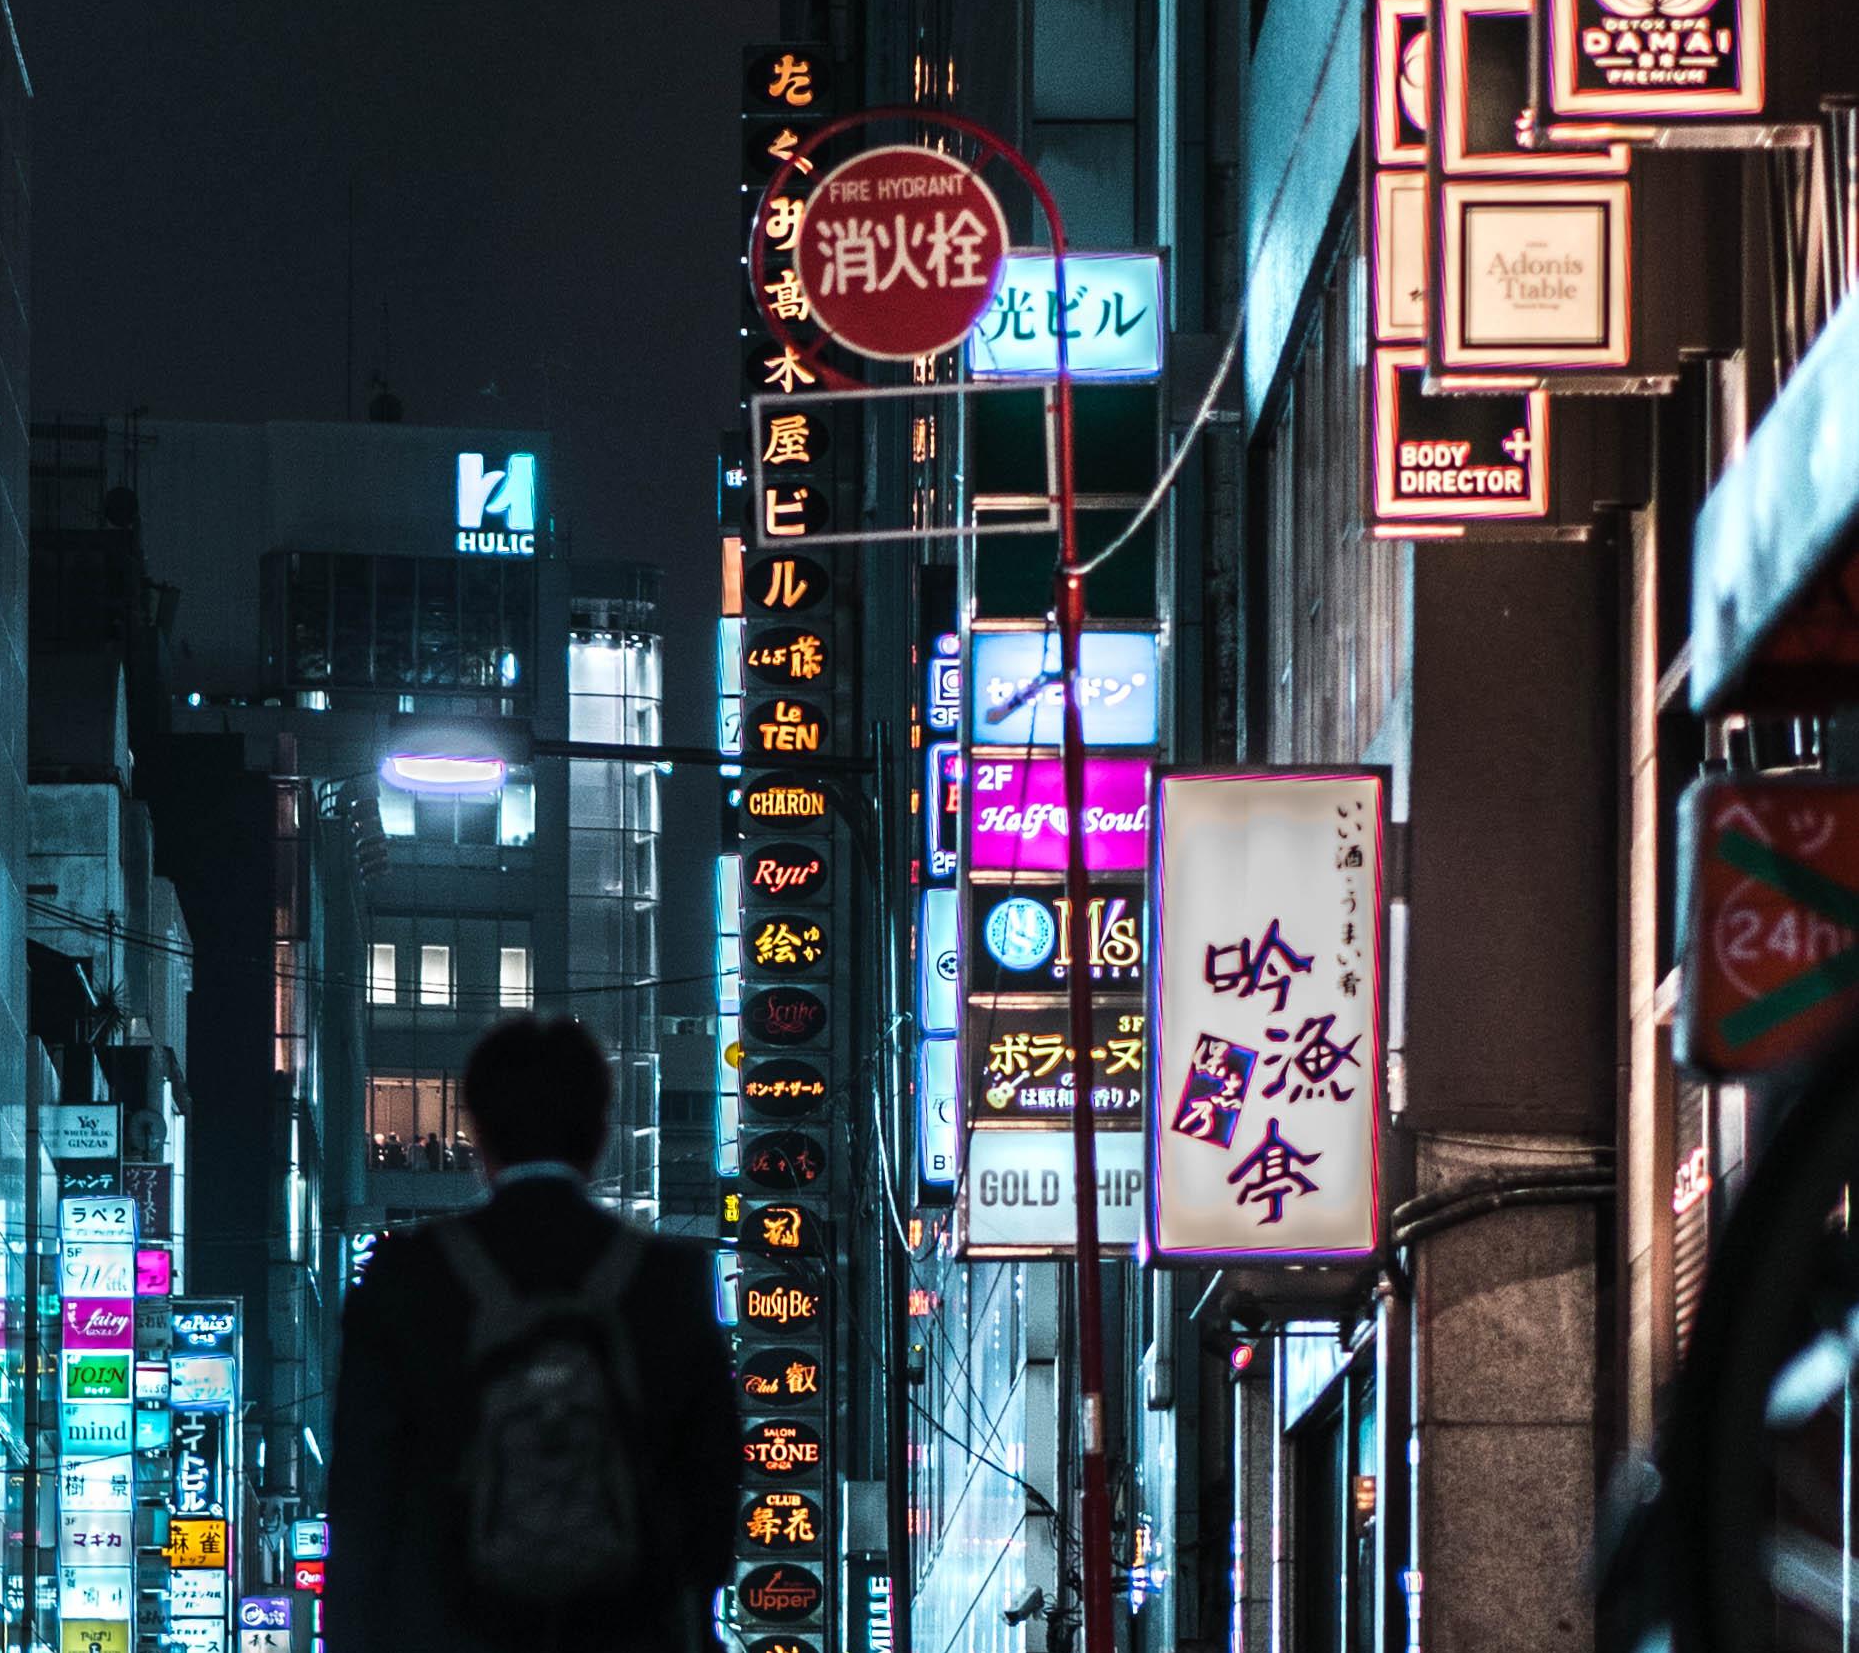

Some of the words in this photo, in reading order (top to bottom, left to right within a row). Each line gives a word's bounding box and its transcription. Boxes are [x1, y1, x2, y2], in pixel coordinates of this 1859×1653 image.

[1582, 30, 1732, 55] DAMAI
[829, 178, 871, 204] FIRE
[878, 174, 965, 200] HYDRANT
[816, 209, 988, 297] 消火栓
[1486, 252, 1584, 277] Adonis
[1399, 443, 1471, 469] BODY
[1399, 469, 1523, 494] DIRECTOR
[458, 531, 535, 554] HULIC
[776, 701, 802, 722] Le
[758, 723, 821, 752] TEN
[976, 764, 1014, 791] 2F
[748, 793, 825, 816] CHARON
[977, 804, 1050, 840] Half
[980, 1169, 1060, 1207] GOLD
[1074, 1169, 1143, 1207] HIP
[69, 1366, 128, 1387] JOIN
[68, 1421, 127, 1441] mind
[763, 1427, 797, 1438] SALON
[765, 1494, 803, 1507] CLUB
